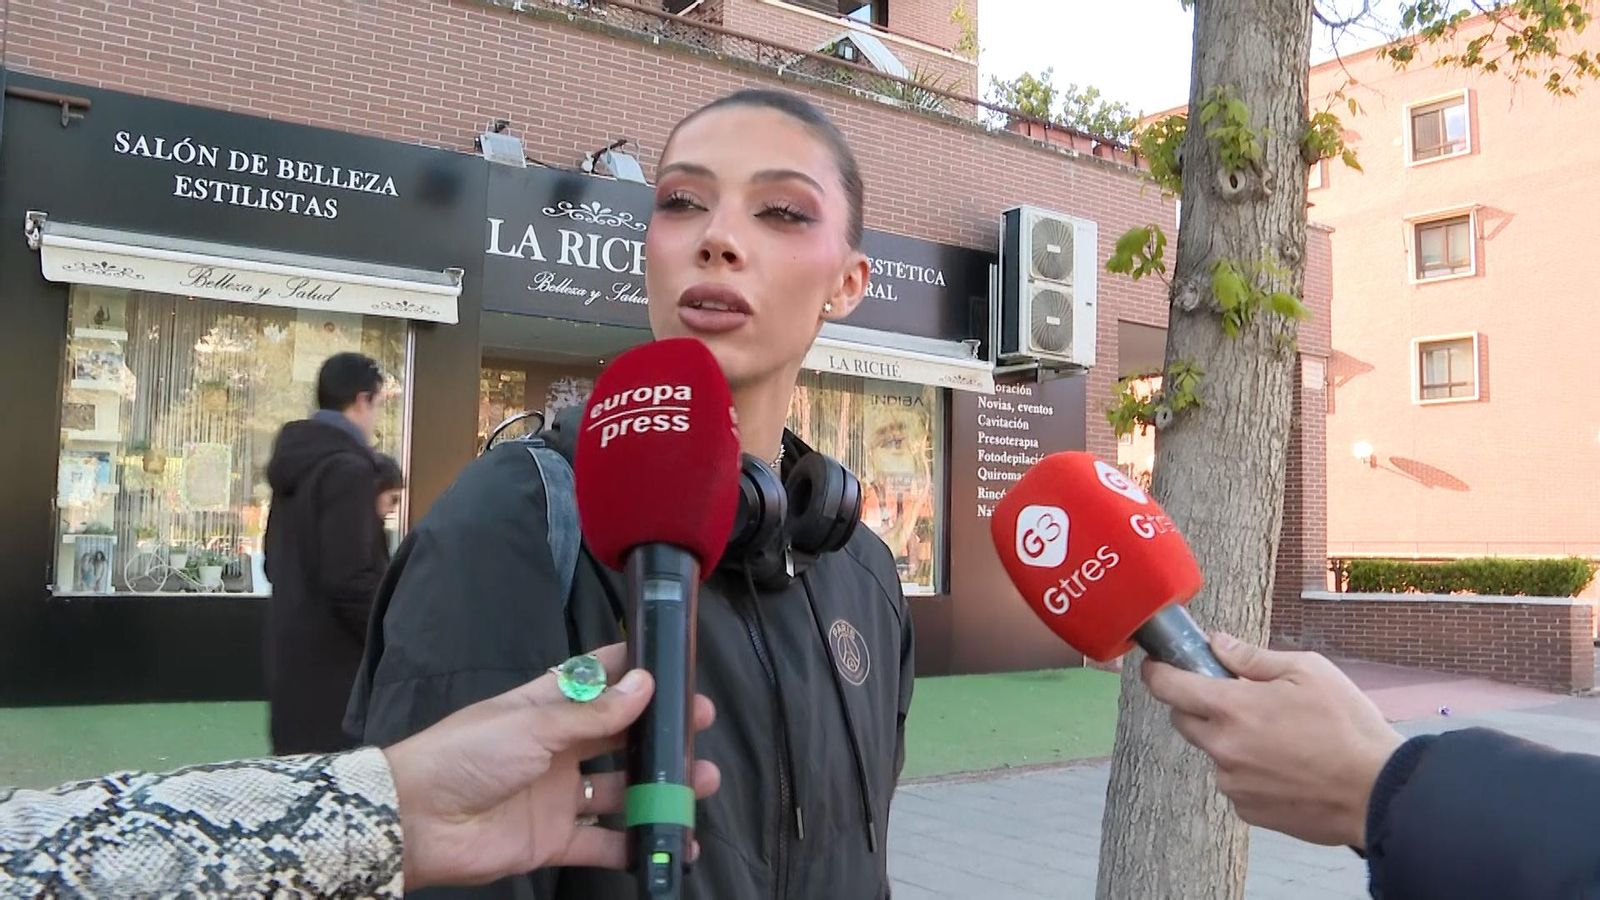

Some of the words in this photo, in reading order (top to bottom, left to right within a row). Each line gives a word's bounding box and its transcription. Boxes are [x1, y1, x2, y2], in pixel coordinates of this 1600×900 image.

[114, 131, 219, 167] SALÓN
[227, 150, 268, 175] DE
[276, 157, 399, 197] BELLEZA
[173, 174, 338, 219] ESTILISTAS
[485, 217, 547, 262] LA
[180, 264, 252, 292] Belleza
[254, 286, 271, 300] y
[278, 276, 342, 302] Salud
[527, 271, 587, 297] Belleza
[584, 289, 601, 305] y
[829, 355, 850, 371] LA
[854, 361, 902, 379] RICHÉ
[590, 384, 692, 419] europa
[977, 396, 1015, 413] Novias,
[1017, 402, 1054, 415] eventos
[600, 414, 690, 448] press
[977, 414, 1029, 430] Cavitación
[977, 431, 1039, 449] Presoterapia
[977, 467, 1025, 481] Quiroma
[1022, 512, 1062, 559] G3
[1043, 544, 1120, 615] Gtres
